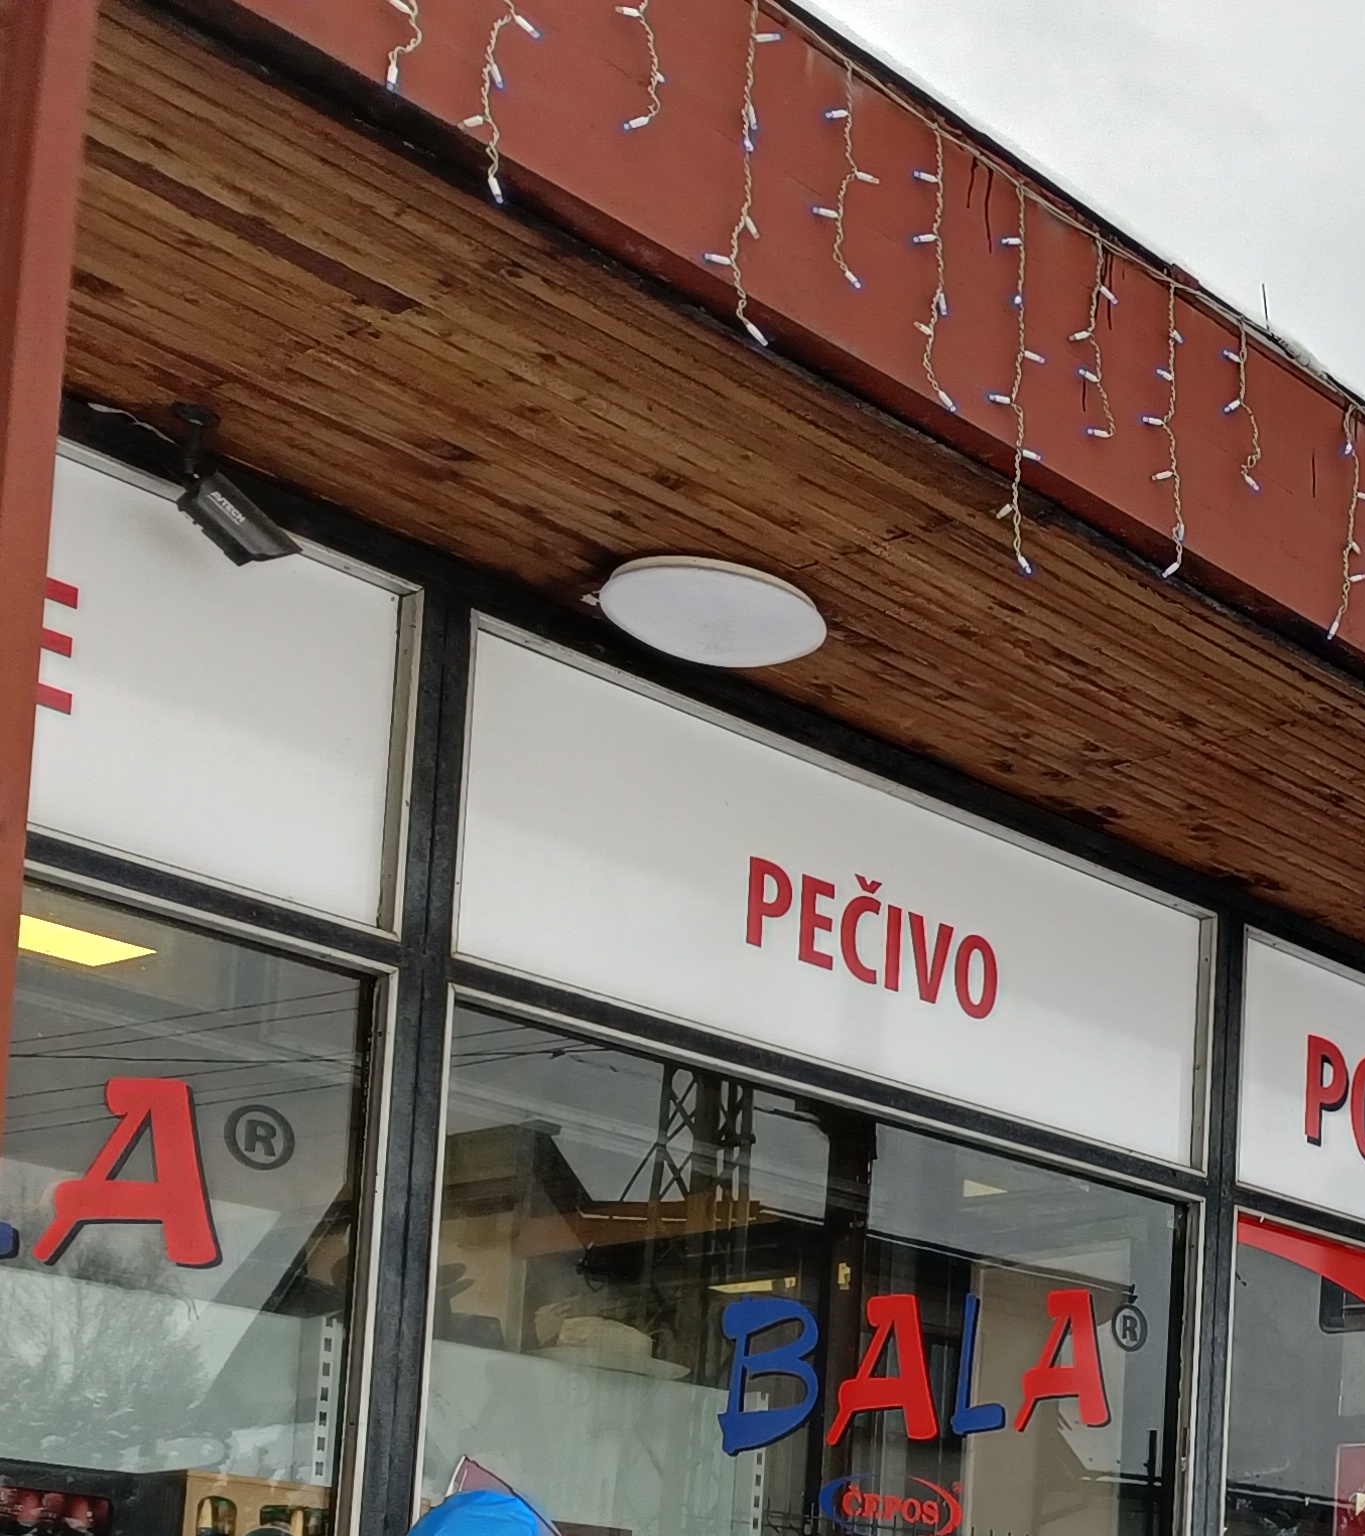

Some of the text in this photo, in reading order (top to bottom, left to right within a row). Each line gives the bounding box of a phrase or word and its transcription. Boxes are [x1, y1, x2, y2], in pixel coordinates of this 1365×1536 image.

[745, 856, 998, 1020] PEČIVO
[718, 1288, 1112, 1457] BALA
[842, 1484, 941, 1526] ČEPOS
